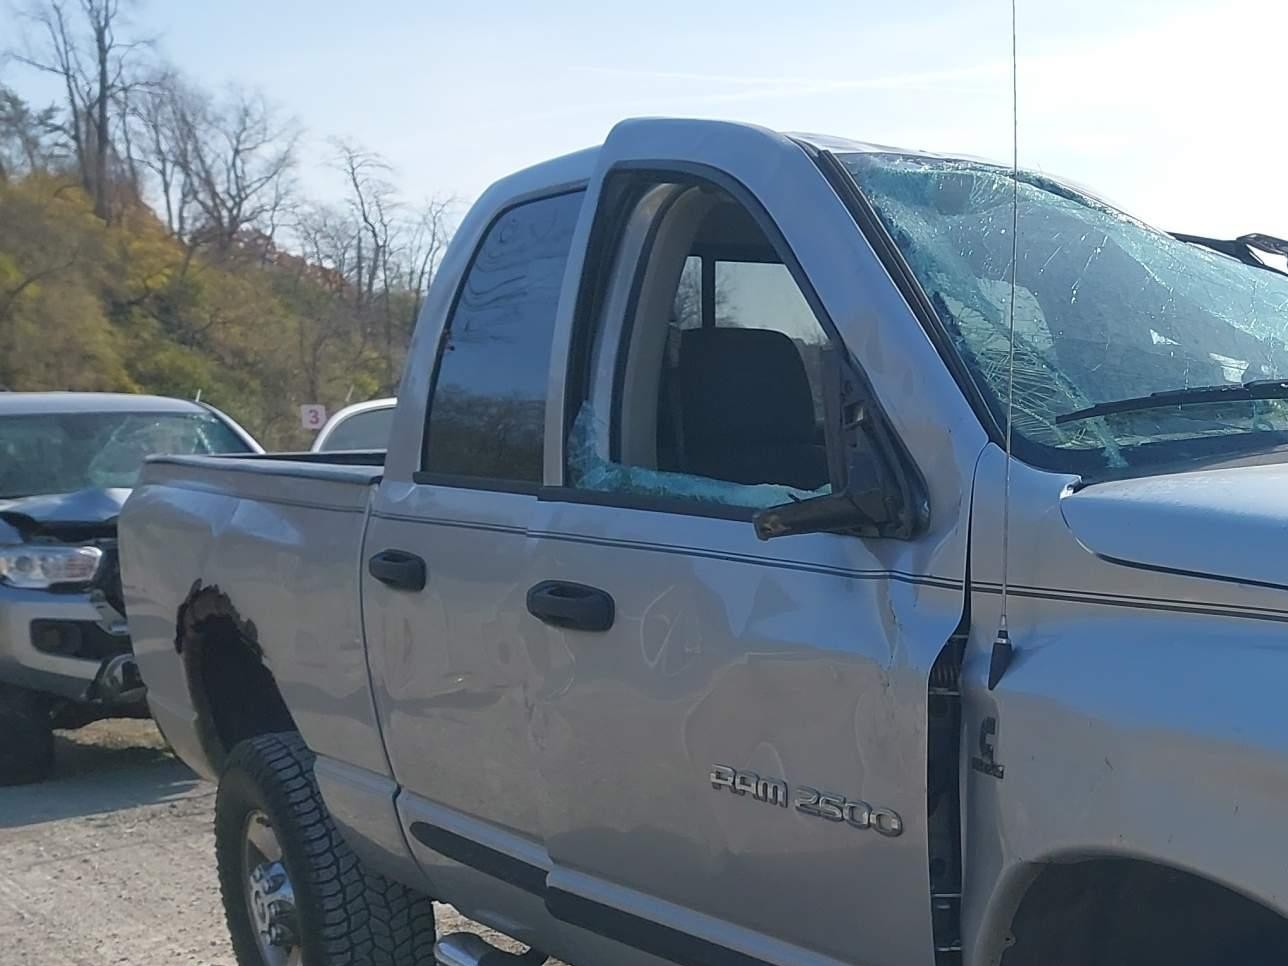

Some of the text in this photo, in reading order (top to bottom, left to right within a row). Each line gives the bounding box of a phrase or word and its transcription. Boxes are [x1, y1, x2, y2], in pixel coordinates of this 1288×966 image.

[309, 409, 320, 425] 3
[710, 763, 903, 838] RAM 2500
